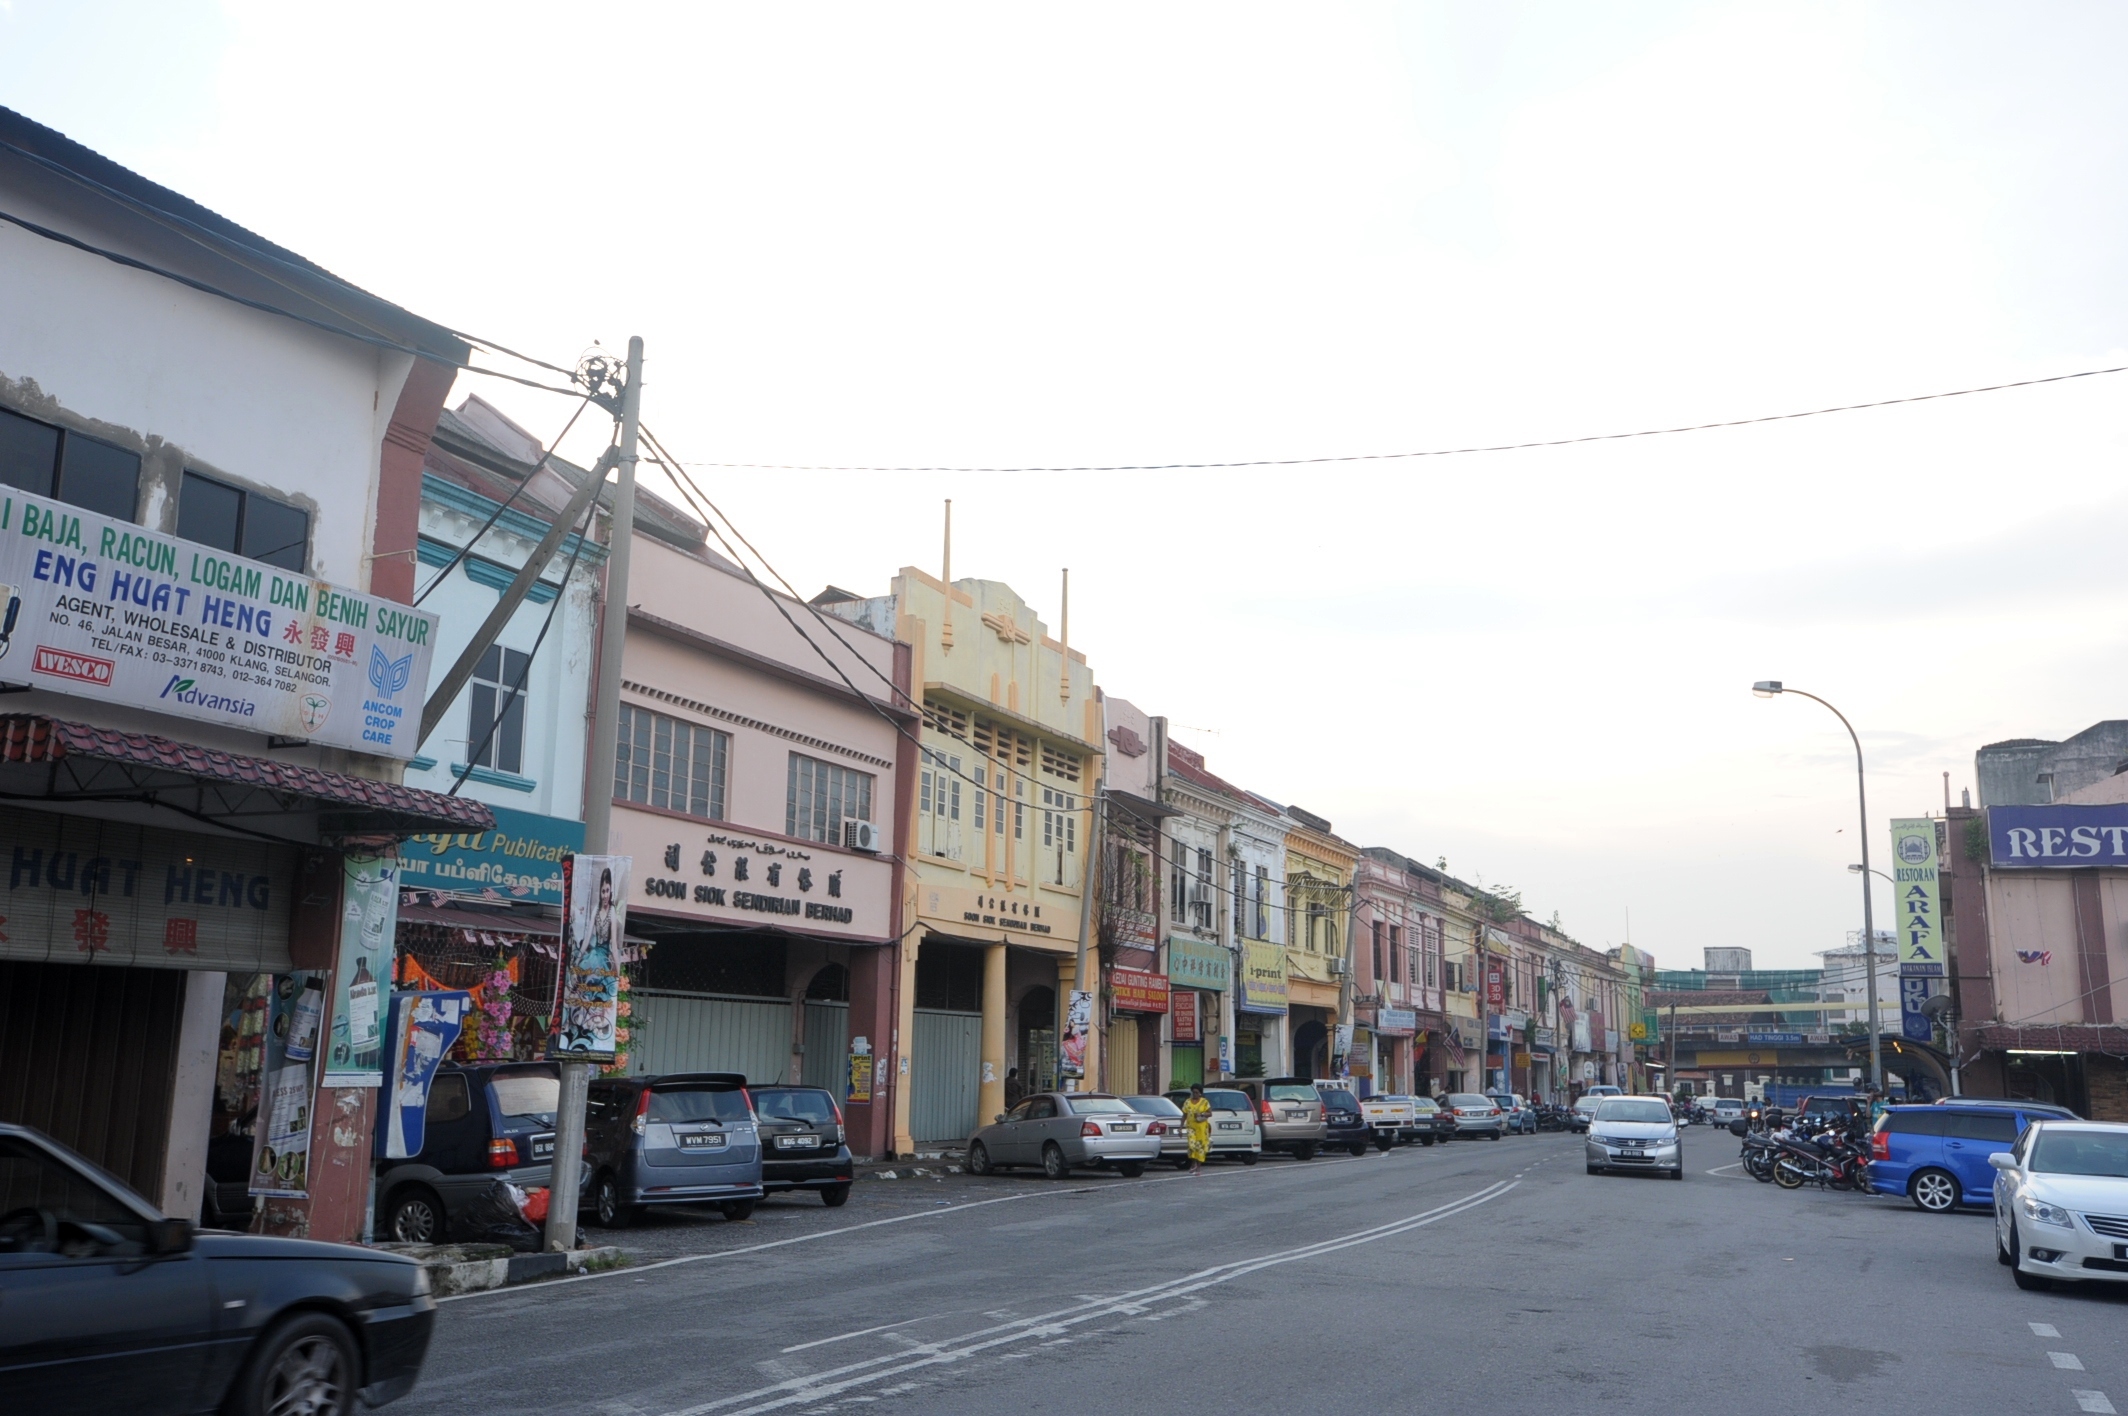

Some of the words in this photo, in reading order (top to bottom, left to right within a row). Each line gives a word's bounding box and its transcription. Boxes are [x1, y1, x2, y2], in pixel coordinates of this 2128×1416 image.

[21, 503, 88, 556] BAJA,
[100, 526, 180, 582] RACUN,
[190, 552, 262, 600] LOGAM
[269, 576, 309, 613] DAN
[316, 590, 369, 630] BENIH
[375, 607, 430, 647] SAYUR
[33, 549, 97, 593] ENG
[110, 570, 191, 616] HUAT
[202, 595, 272, 638] HENG
[49, 611, 71, 627] NO.
[101, 625, 143, 643] JALAN
[147, 634, 190, 656] BESAR,
[195, 646, 226, 662] 41000
[230, 652, 270, 674] KLANG,
[274, 664, 331, 688] SELANGOR.
[56, 594, 115, 623] AGENT,
[124, 609, 220, 646] WHOLESALE
[225, 637, 236, 650] &
[243, 640, 332, 674] DISTRIBUTOR
[38, 651, 111, 681] WESCO
[199, 661, 226, 679] 8743,
[274, 676, 297, 693] 7082
[159, 674, 256, 718] Advansia
[362, 699, 403, 719] ANCOM
[362, 729, 393, 746] CARE
[364, 715, 396, 731] CROP
[9, 846, 143, 898] HUAT
[164, 863, 270, 911] HENG
[1896, 867, 1935, 882] RESTORAN
[645, 877, 687, 900] SOON
[693, 885, 727, 906] SIOK
[732, 890, 801, 916] SENDIRIAN
[805, 900, 853, 924] BERHAD
[1904, 884, 1934, 960] ARAFA
[1249, 964, 1282, 980] i-print
[1904, 978, 1925, 1014] UKU
[685, 1136, 703, 1145] WVM
[702, 1135, 722, 1144] 7951
